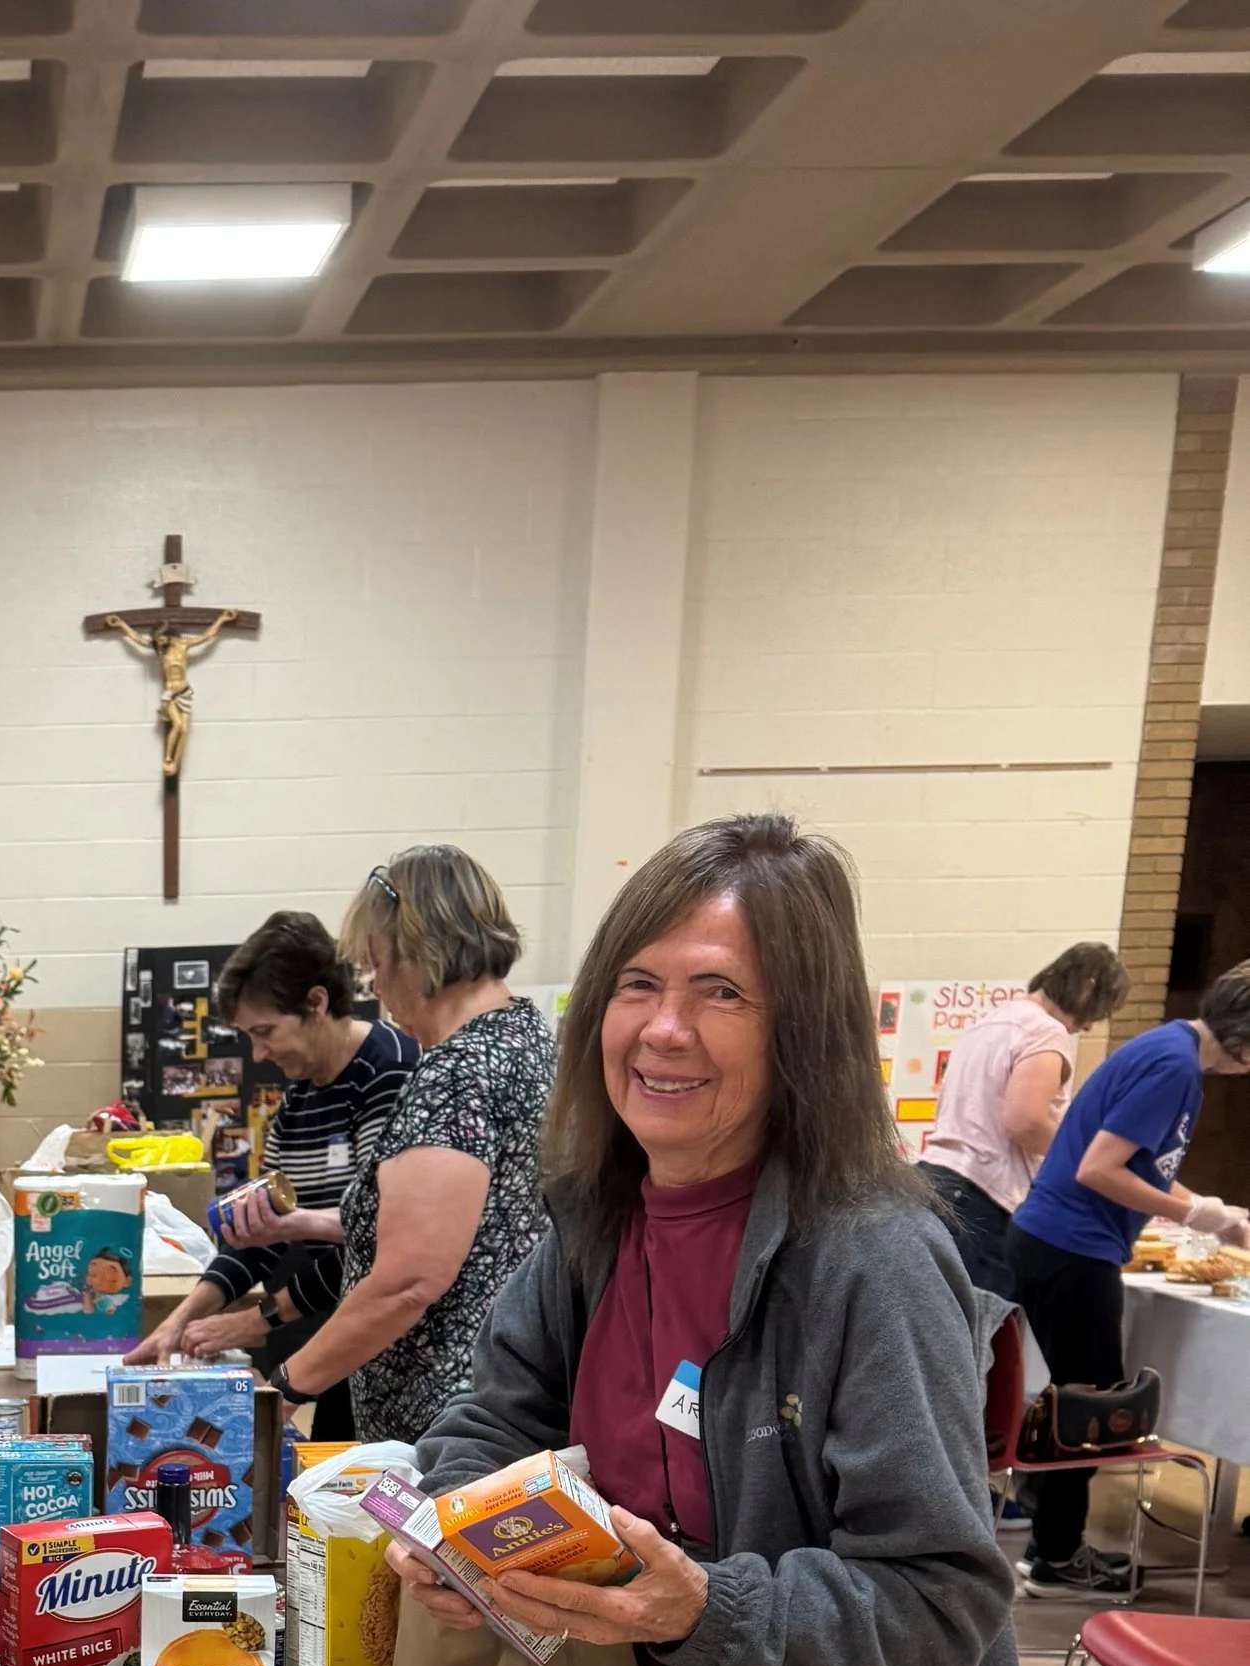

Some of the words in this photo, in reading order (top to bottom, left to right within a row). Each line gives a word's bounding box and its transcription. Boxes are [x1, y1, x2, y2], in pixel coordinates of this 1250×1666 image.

[26, 1240, 83, 1262] Angel
[38, 1259, 77, 1279] Soft
[236, 1381, 248, 1391] 50
[23, 1485, 55, 1501] HOT
[25, 1496, 78, 1518] COCOA
[48, 1540, 77, 1548] SIMPLE
[49, 1546, 81, 1554] INGREDIENT
[493, 1522, 564, 1558] Annie's
[39, 1558, 154, 1613] Minute
[189, 1600, 231, 1611] Essential
[33, 1648, 77, 1666] WHITE
[82, 1640, 112, 1656] RICE
